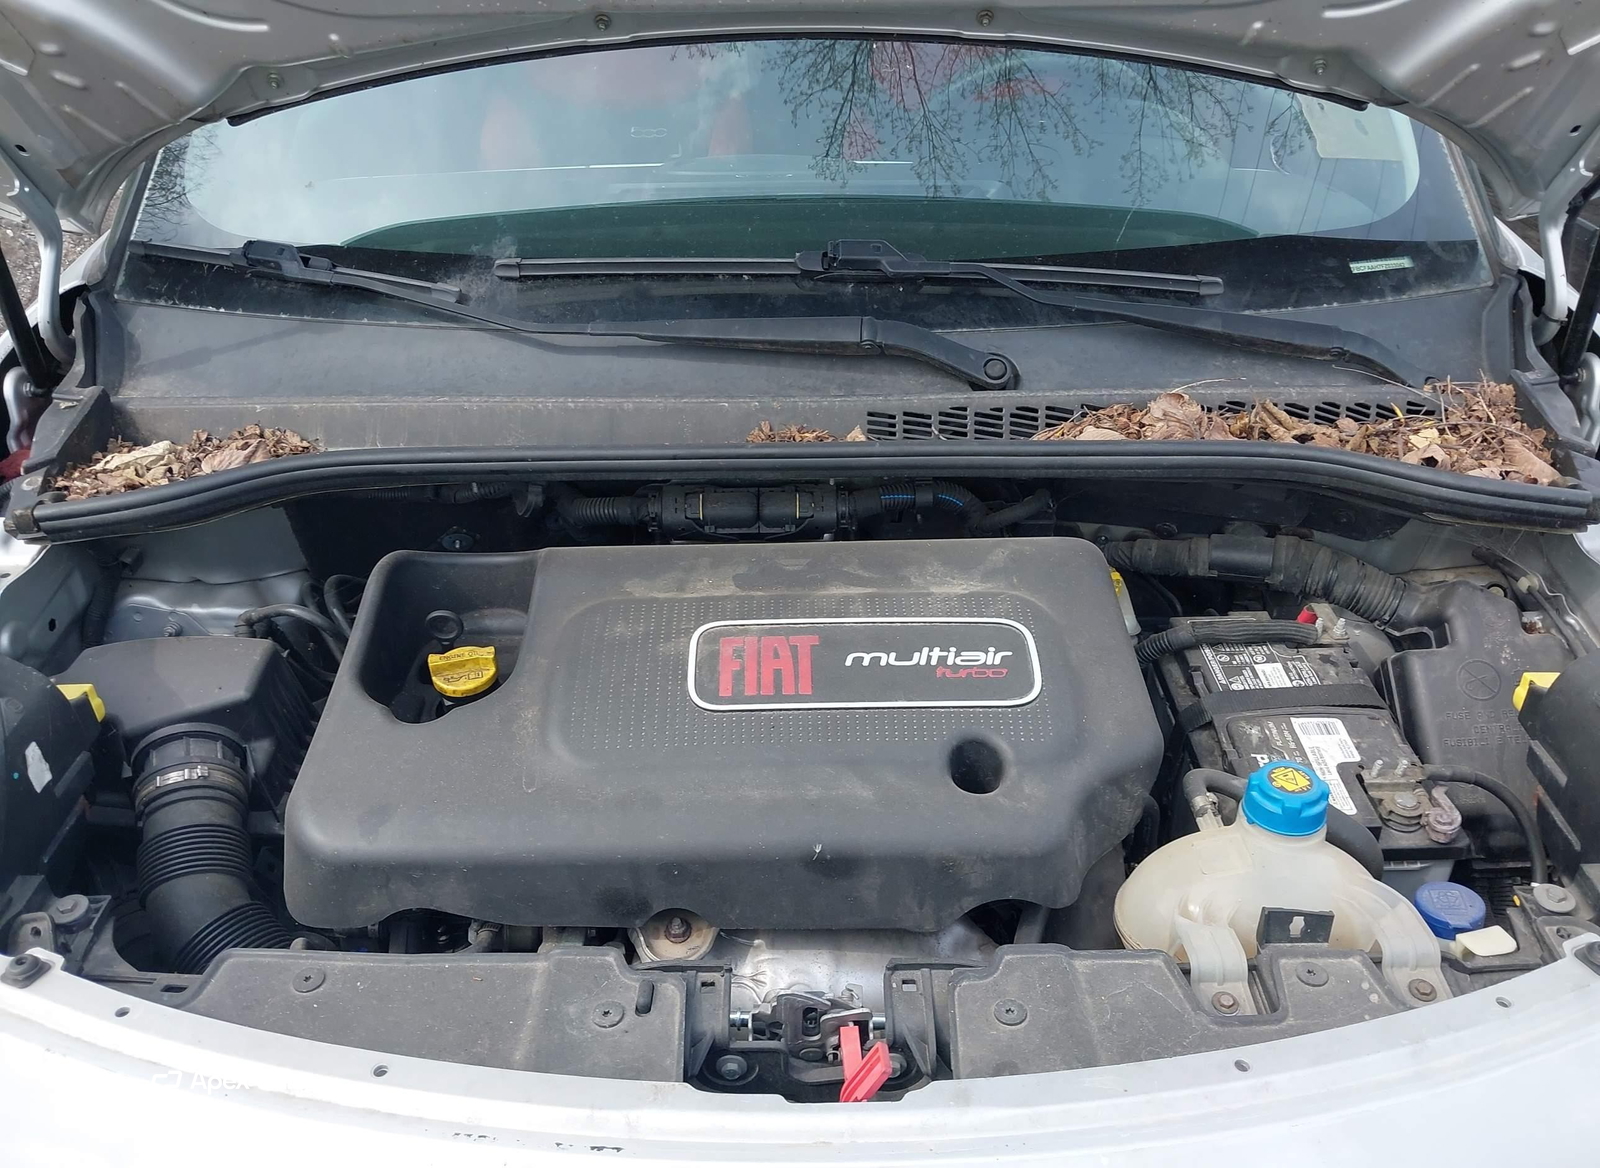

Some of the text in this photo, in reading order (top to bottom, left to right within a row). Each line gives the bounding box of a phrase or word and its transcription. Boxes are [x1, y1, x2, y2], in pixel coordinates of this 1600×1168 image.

[844, 646, 1013, 667] multiair
[718, 635, 819, 697] FIAT
[936, 666, 1008, 679] turbo
[1445, 711, 1471, 720] FUSE
